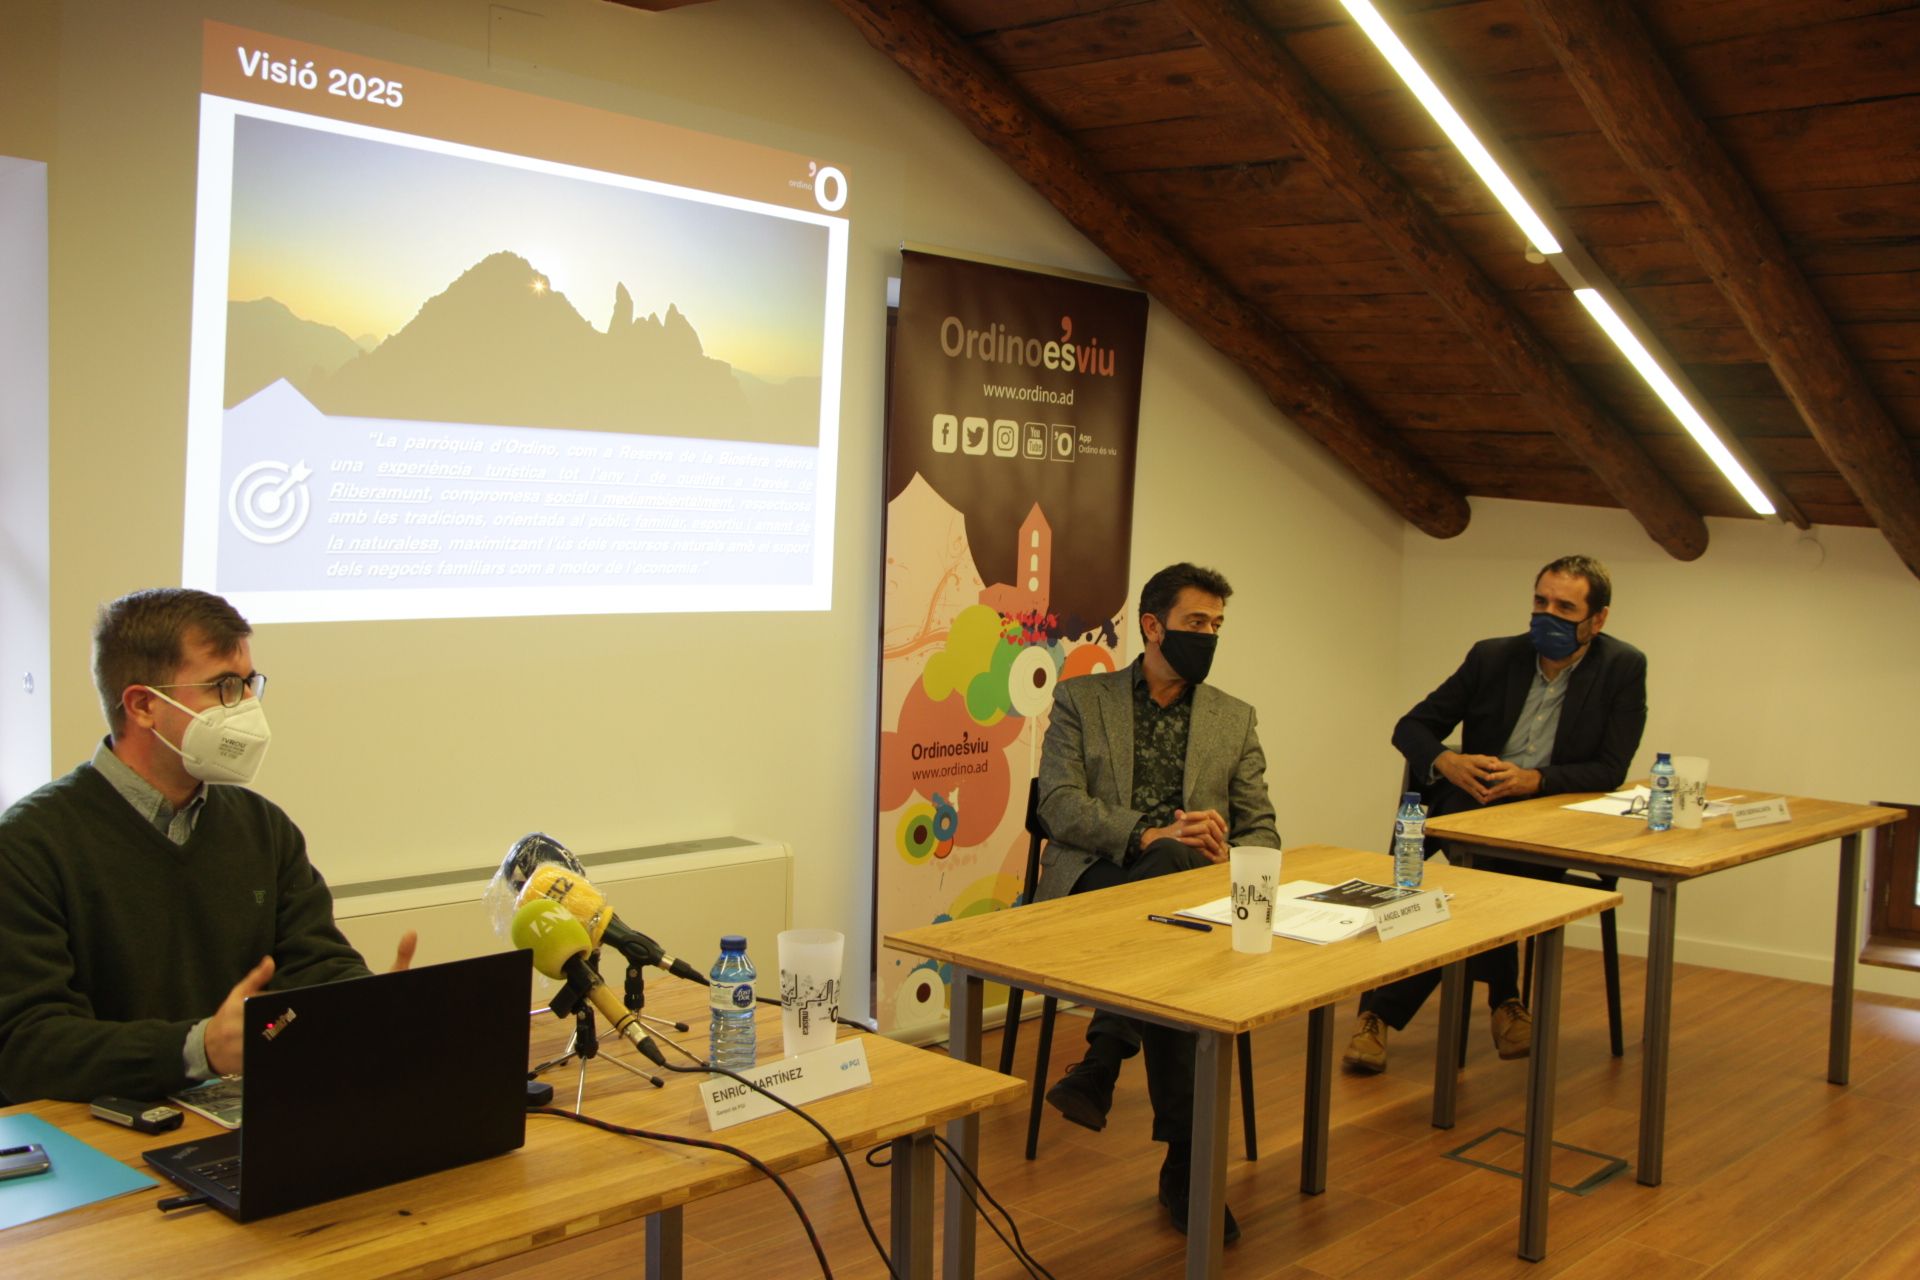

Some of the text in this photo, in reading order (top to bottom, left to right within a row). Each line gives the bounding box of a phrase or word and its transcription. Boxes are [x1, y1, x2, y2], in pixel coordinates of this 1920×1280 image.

[237, 46, 404, 108] Visió 2025
[983, 383, 1075, 406] www.ordino.ad
[404, 434, 484, 454] parròquia
[567, 445, 597, 458] com
[604, 448, 613, 459] a
[620, 444, 674, 462] Reserva
[680, 448, 696, 463] de
[702, 449, 714, 464] la
[1079, 433, 1092, 444] App
[1079, 445, 1098, 454] Ordino
[331, 458, 364, 474] una
[376, 458, 473, 478] experiència
[485, 463, 548, 480] turística
[559, 467, 581, 480] tot
[650, 470, 667, 484] de
[329, 482, 434, 503] Riberamunt,
[440, 488, 541, 505] compromesa
[543, 489, 589, 506] social
[327, 509, 367, 525] amb
[371, 510, 399, 526] les
[404, 510, 488, 529] tradicions,
[493, 511, 566, 527] orientada
[570, 512, 585, 528] al
[588, 513, 631, 531] públic
[327, 534, 345, 552] la
[348, 535, 443, 553] naturalesa,
[447, 535, 543, 552] maximitzant
[577, 535, 608, 552] dels
[611, 539, 669, 553] recursos
[671, 538, 725, 553] naturals
[727, 538, 755, 553] amb
[326, 560, 363, 577] dels
[367, 561, 433, 581] negocis
[437, 560, 506, 577] familiars
[510, 562, 542, 576] com
[545, 563, 554, 576] a
[558, 560, 602, 576] motor
[605, 559, 622, 575] de
[911, 760, 989, 780] www.ordino.ad
[712, 1083, 748, 1104] ENRIC
